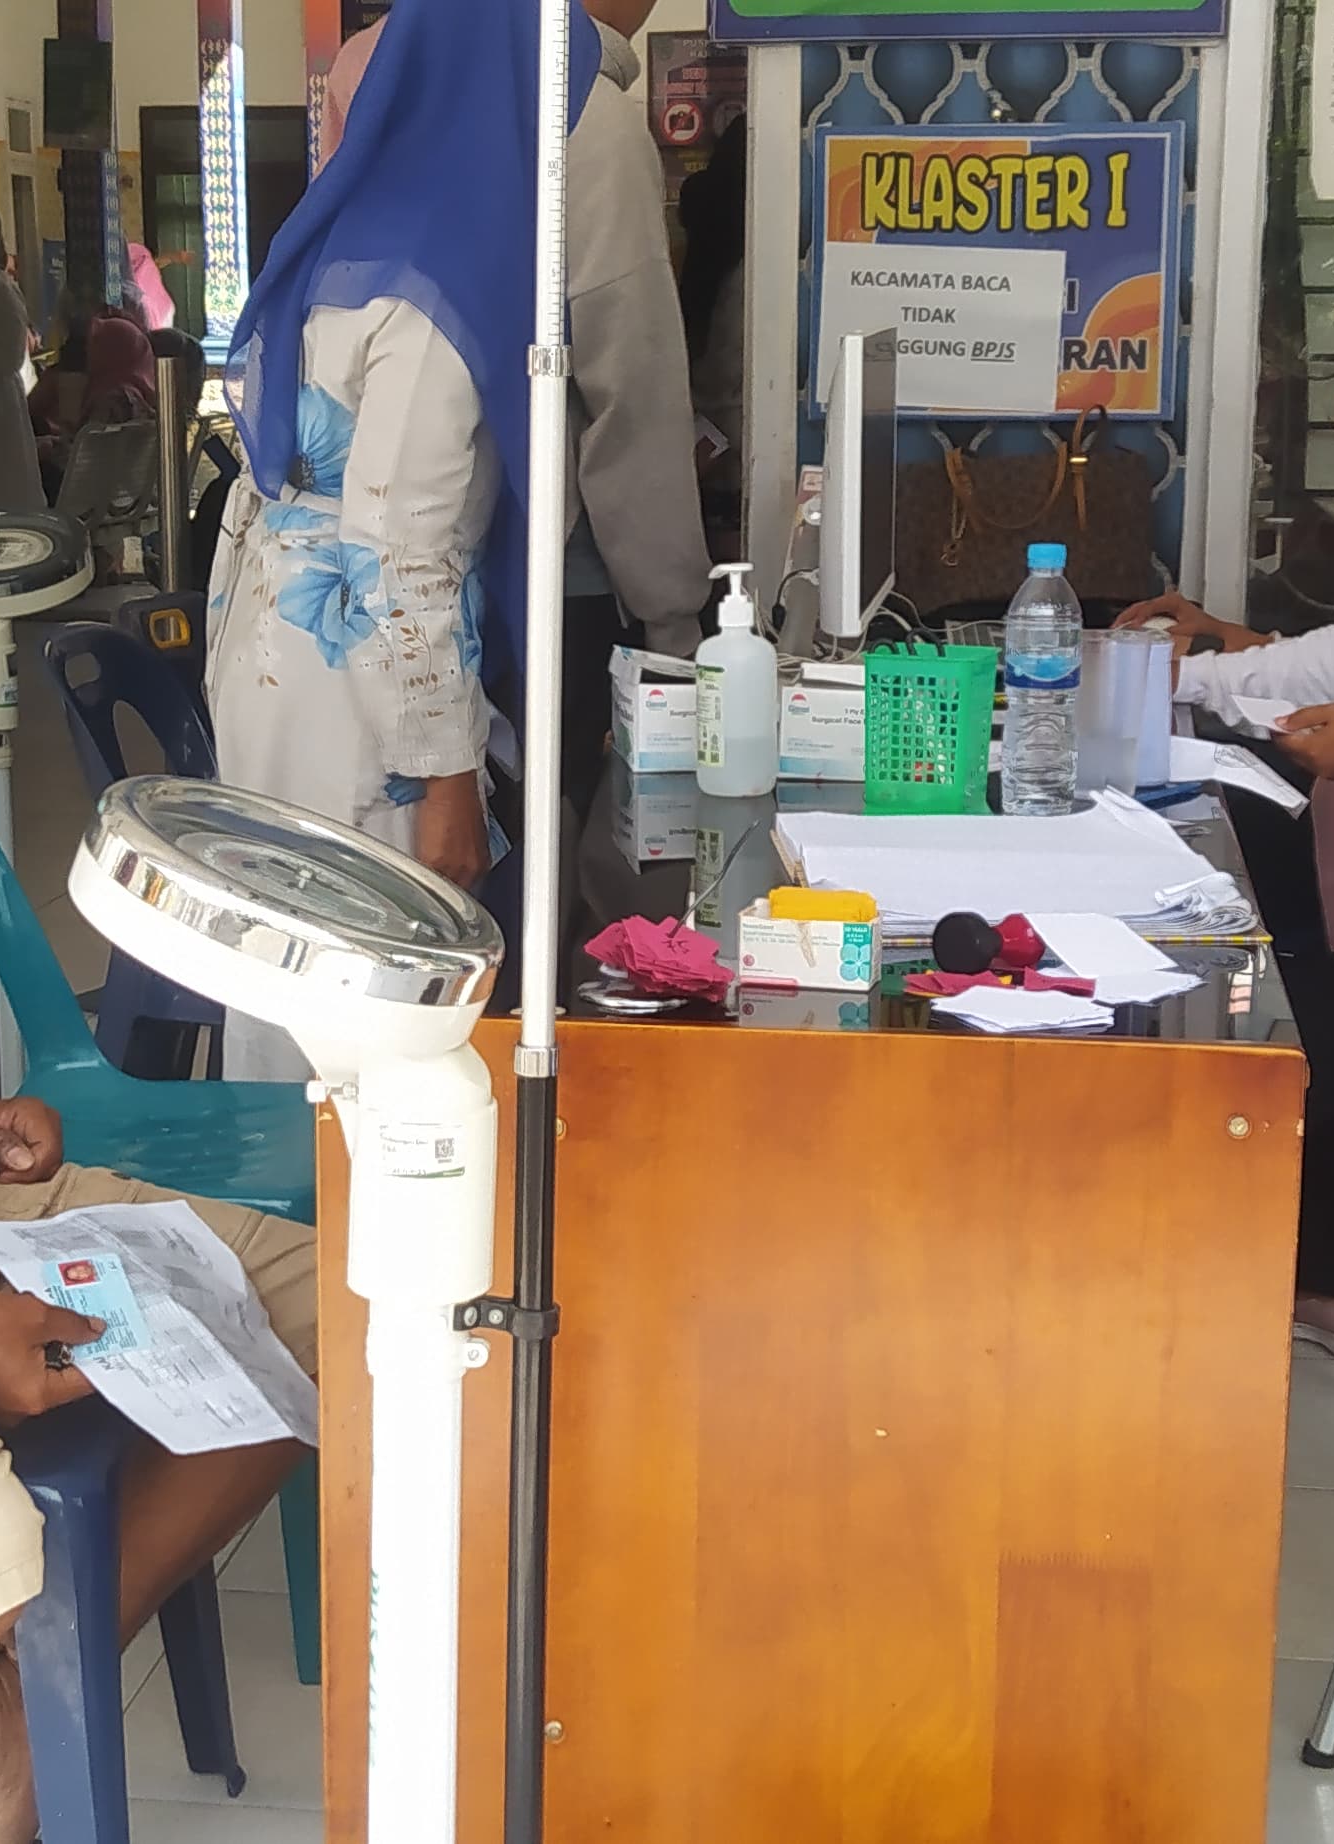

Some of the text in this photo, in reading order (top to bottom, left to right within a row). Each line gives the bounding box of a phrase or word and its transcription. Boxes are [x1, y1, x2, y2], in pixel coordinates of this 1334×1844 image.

[861, 152, 1091, 232] KLASTER
[850, 270, 1011, 292] KACAMATA BACA
[901, 306, 956, 324] TIDAK
[970, 341, 1015, 359] BPJS
